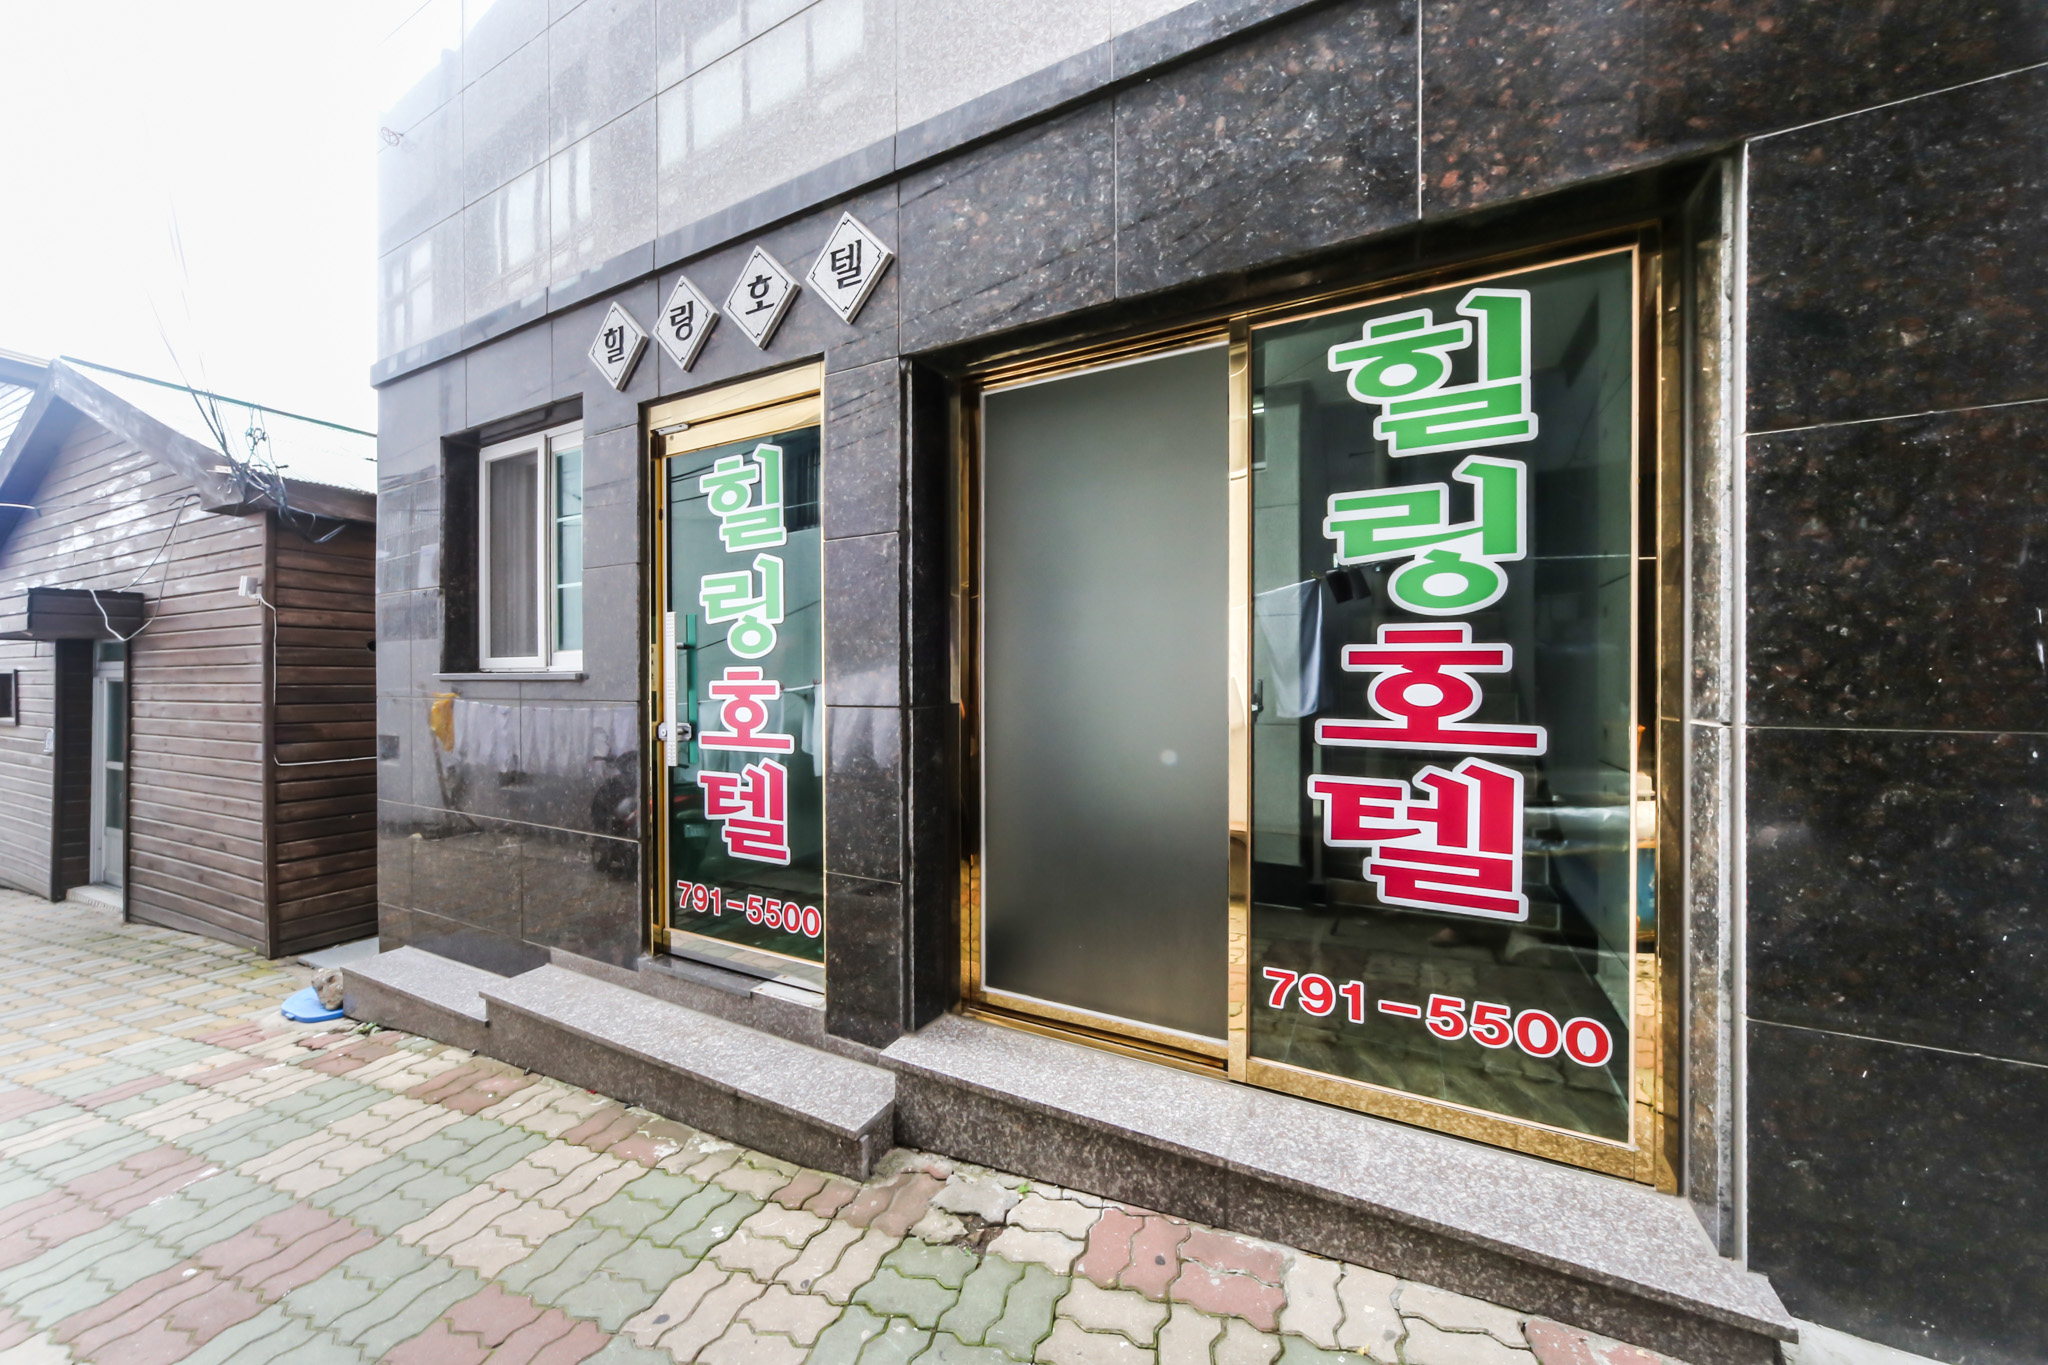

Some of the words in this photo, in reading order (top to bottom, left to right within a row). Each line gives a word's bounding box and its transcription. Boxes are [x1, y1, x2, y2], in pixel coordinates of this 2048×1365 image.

[697, 443, 795, 866] 힐링호텔
[1307, 287, 1547, 922] 힐링호텔
[676, 880, 822, 938] 791-5500
[1262, 966, 1614, 1068] 791-5500
